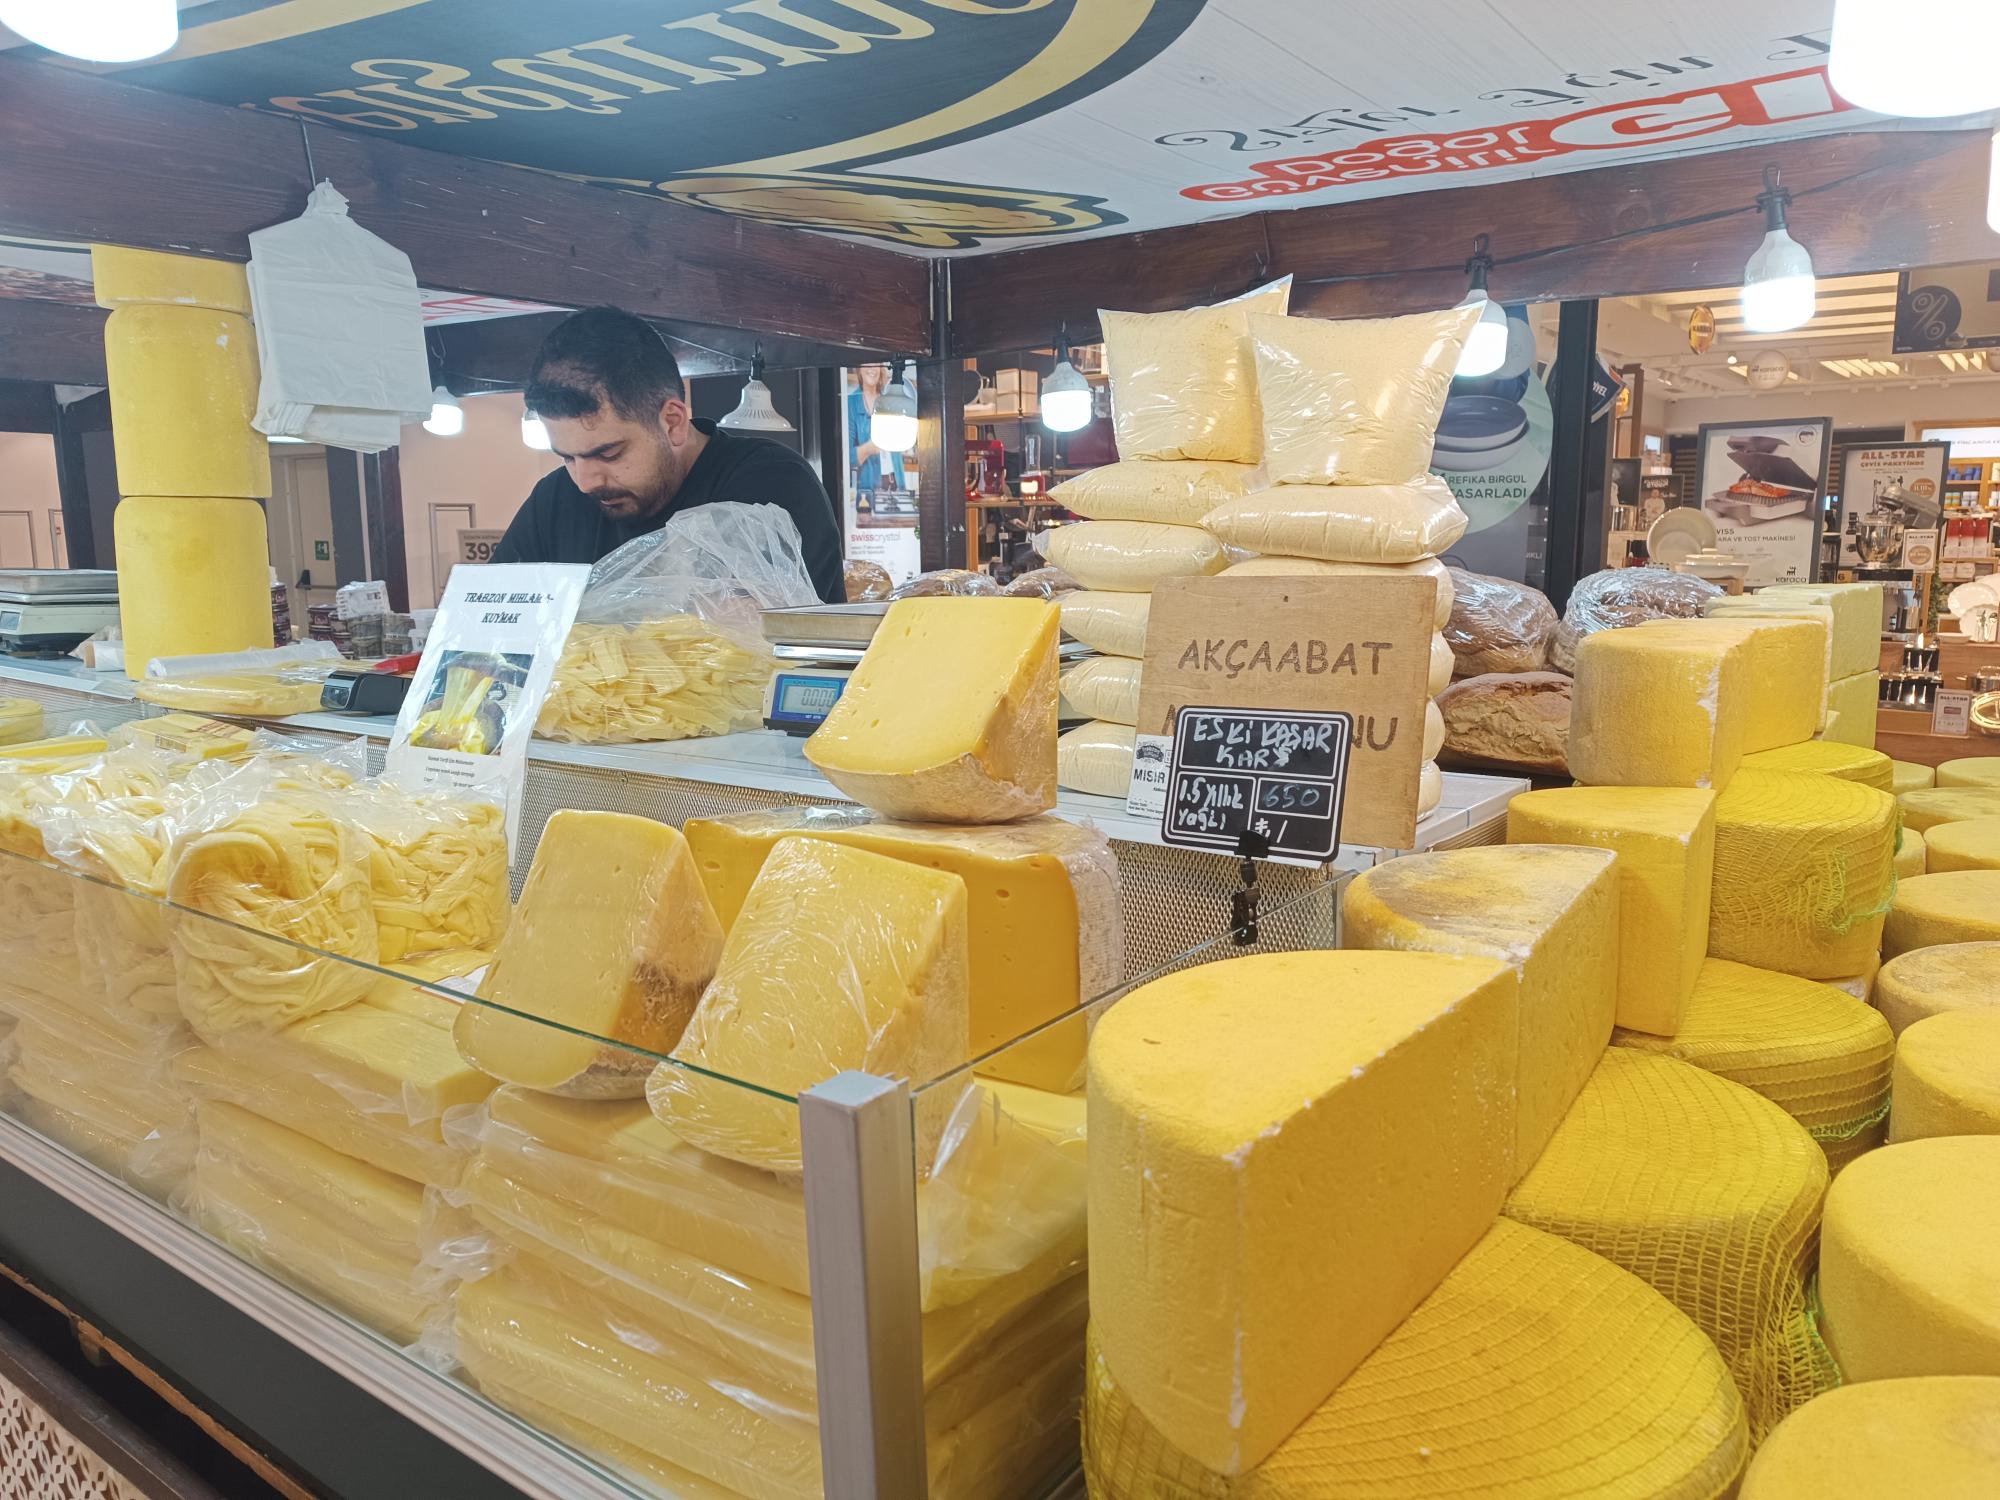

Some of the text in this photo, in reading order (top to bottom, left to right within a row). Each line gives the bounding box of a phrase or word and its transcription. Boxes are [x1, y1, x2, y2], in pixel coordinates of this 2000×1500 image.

[1861, 450, 1926, 460] ALL-STAR
[1451, 487, 1527, 498] ASARLADI
[464, 592, 507, 604] TRABZON
[1178, 640, 1393, 679] AKÇAABAT
[1133, 768, 1166, 785] MISIR
[1264, 783, 1321, 809] 650
